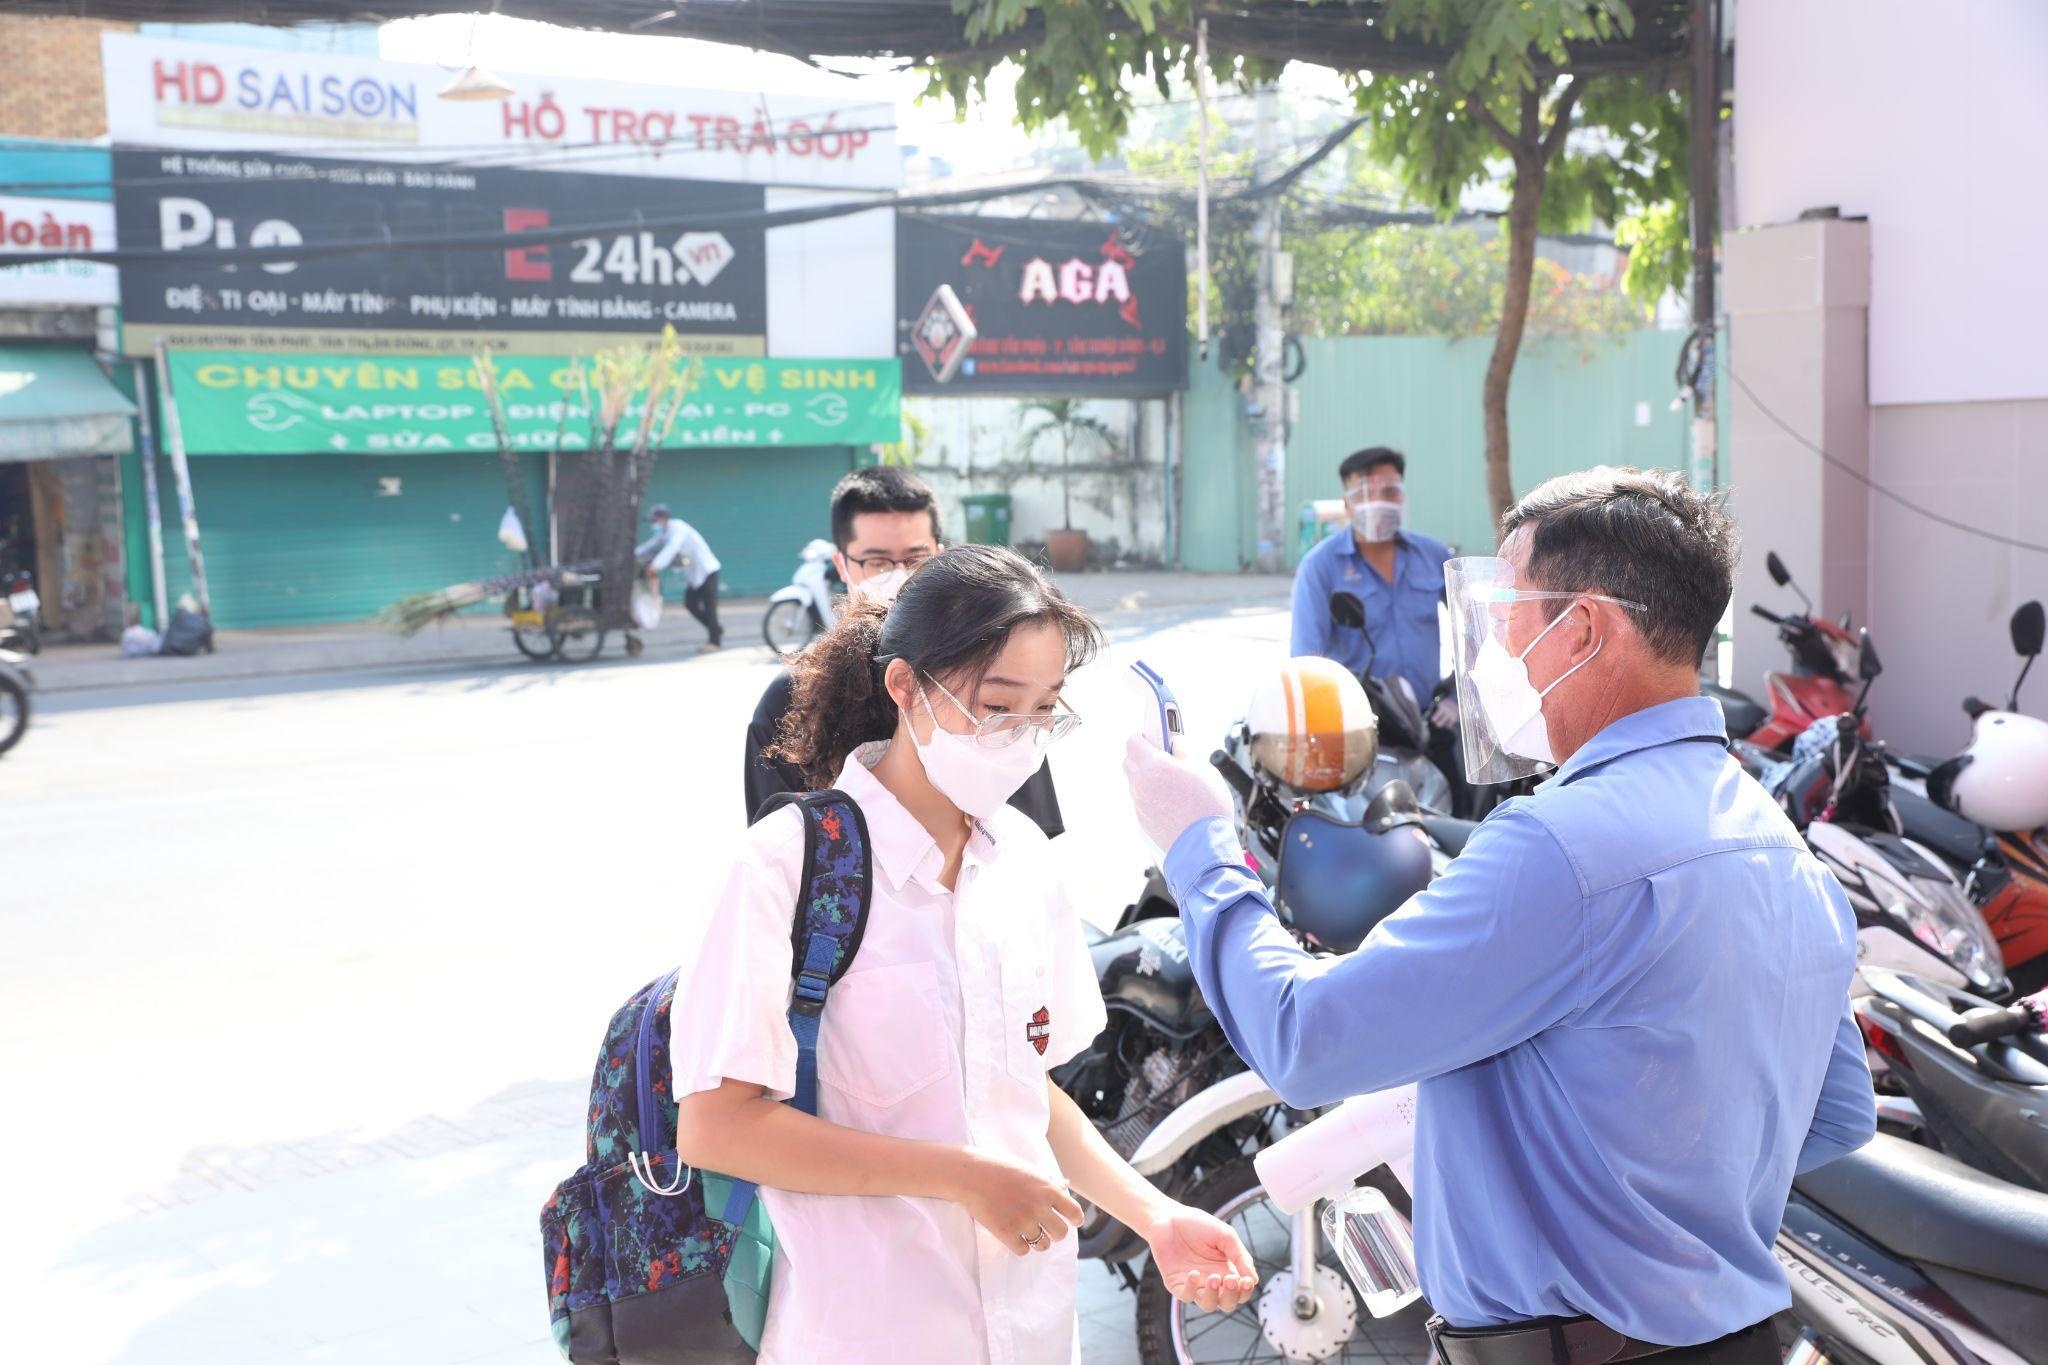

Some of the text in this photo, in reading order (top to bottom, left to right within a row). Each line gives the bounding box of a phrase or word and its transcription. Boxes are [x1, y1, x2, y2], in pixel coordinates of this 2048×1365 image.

[153, 59, 418, 119] HD SAISON
[503, 91, 566, 141] HỖ
[584, 108, 674, 160] TRỢ
[786, 112, 869, 160] GÓP
[1019, 257, 1131, 304] AGA
[302, 287, 348, 314] MÁY
[452, 290, 498, 321] KIỆN
[511, 294, 551, 319] MÁY
[555, 294, 600, 319] TÍNH
[664, 301, 738, 322] CAMERA
[196, 361, 420, 390] CHUYÊN
[715, 363, 766, 395] VỆ
[780, 368, 877, 390] SINH
[320, 403, 474, 420] LAPTOP
[744, 402, 791, 418] PC
